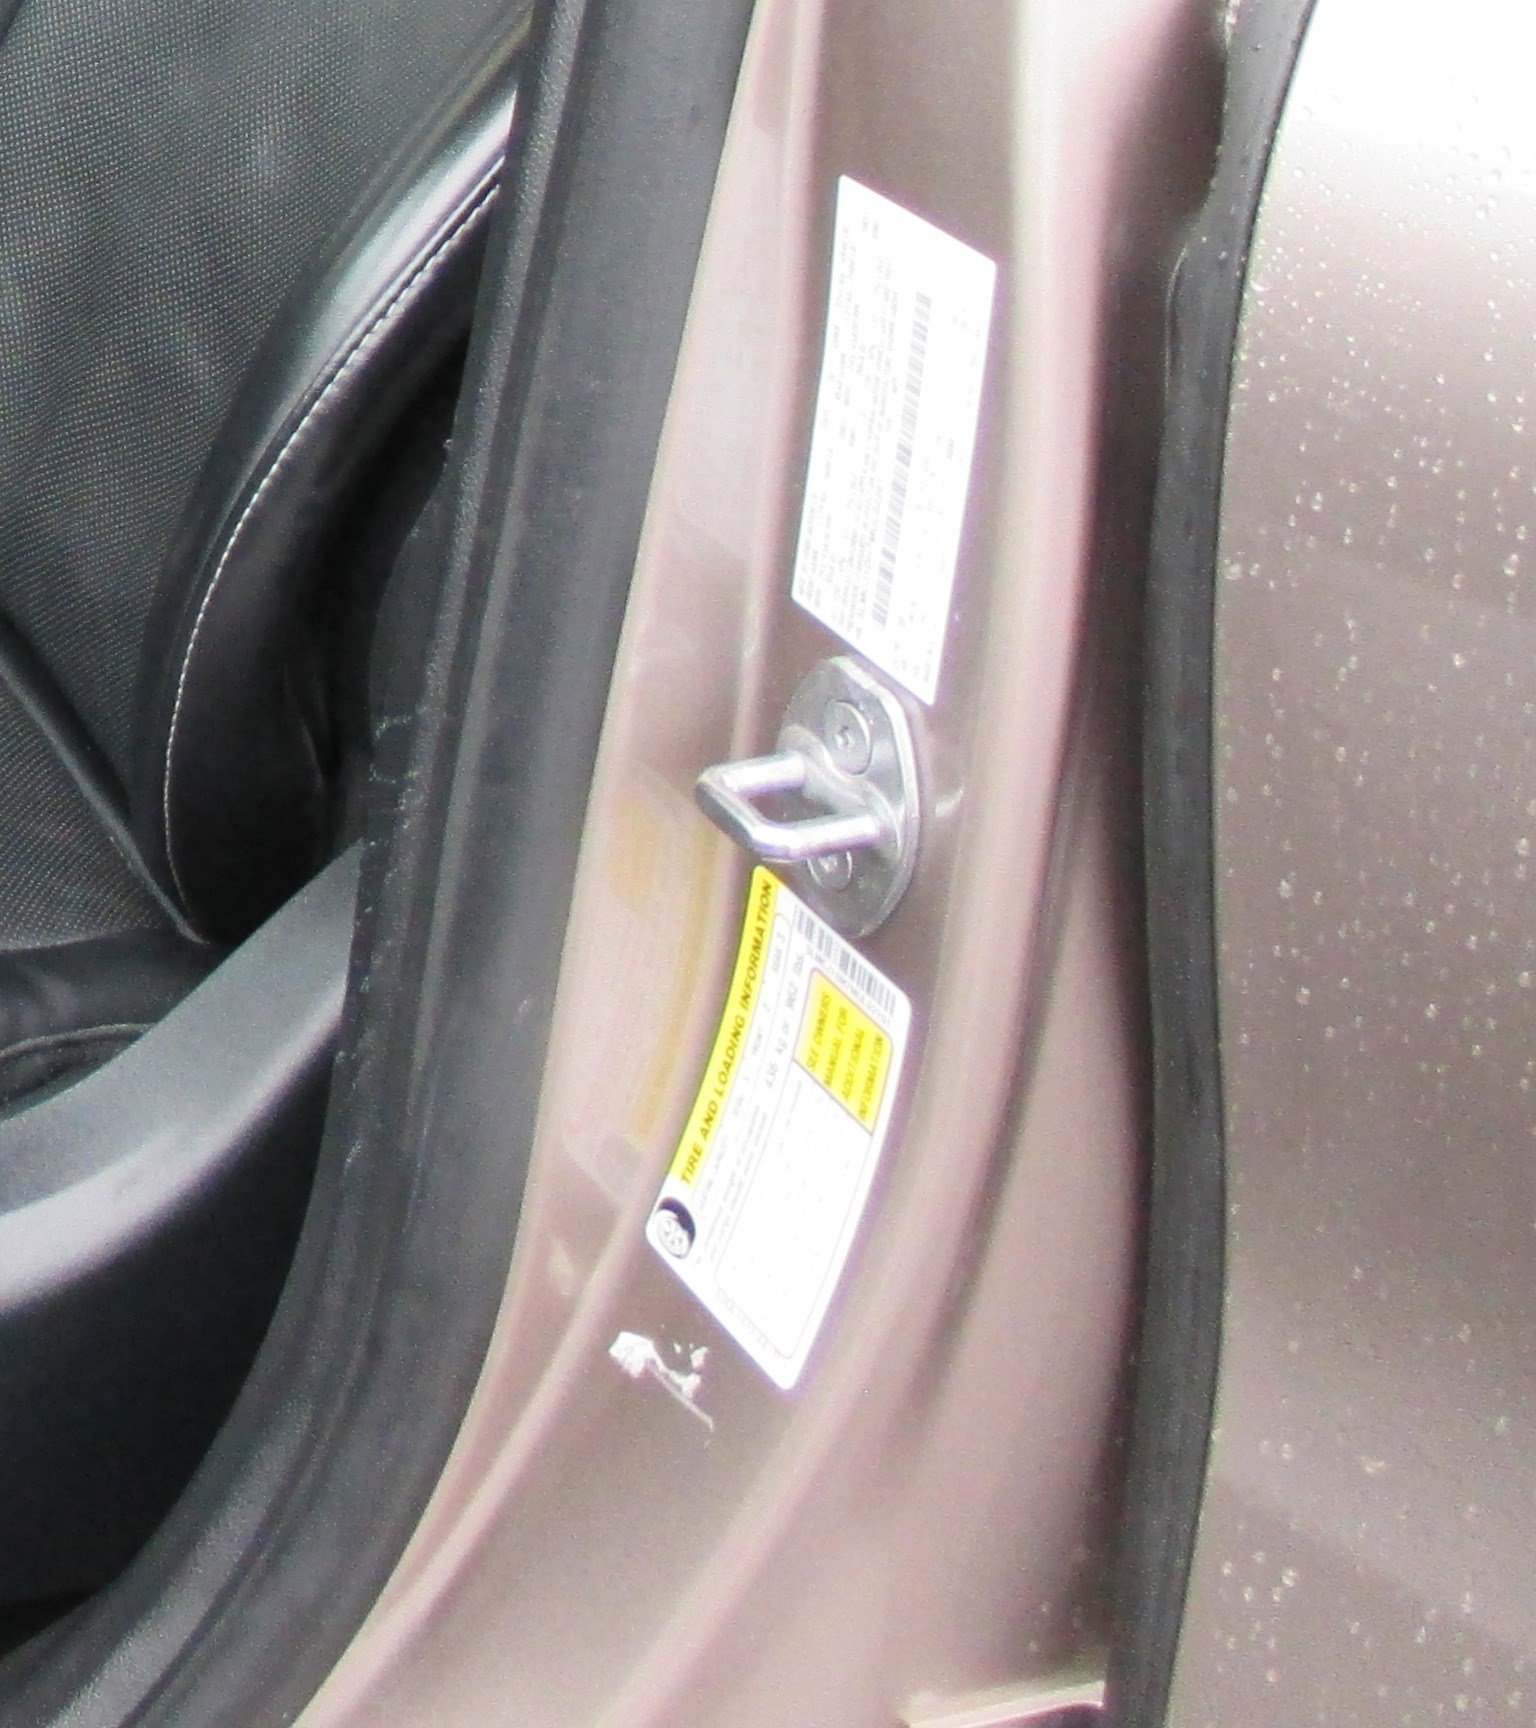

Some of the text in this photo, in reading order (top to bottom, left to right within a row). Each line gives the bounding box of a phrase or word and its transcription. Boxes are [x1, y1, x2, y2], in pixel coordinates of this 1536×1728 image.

[680, 1141, 704, 1186] TIRE
[699, 1098, 720, 1141] AND
[713, 1015, 746, 1098] LOADING
[739, 879, 773, 1010] INFORMATION
[805, 1045, 821, 1071] SEE
[822, 1006, 848, 1089] MANUAL FOR
[841, 1028, 865, 1101] ADDITIONAL
[857, 1034, 884, 1122] INFORMATION
